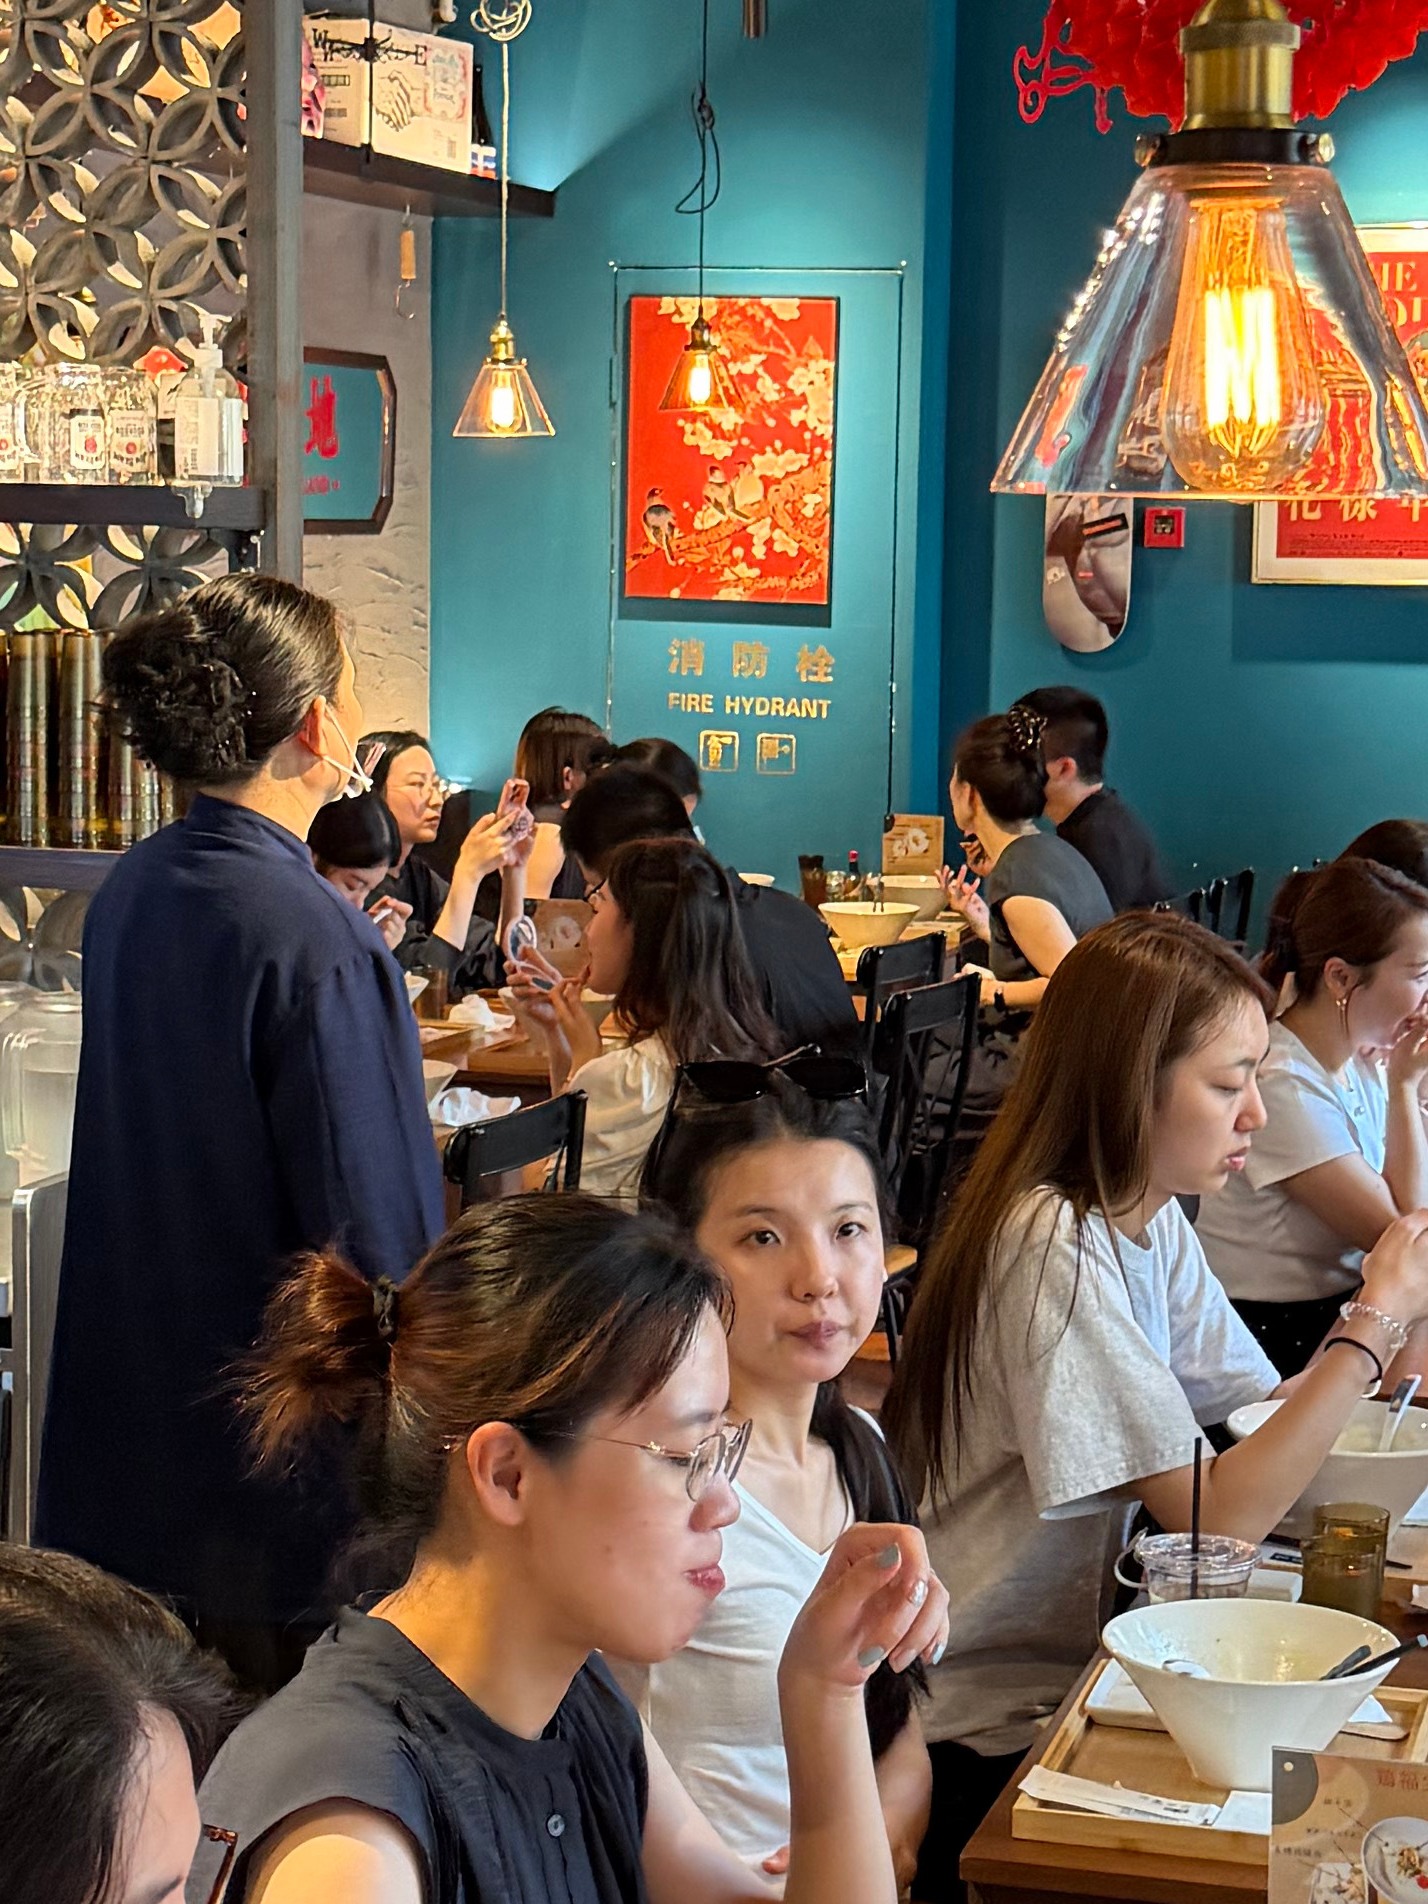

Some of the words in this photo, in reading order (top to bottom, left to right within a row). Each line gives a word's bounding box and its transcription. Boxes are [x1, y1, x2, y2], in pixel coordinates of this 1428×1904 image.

[667, 637, 835, 683] 消防栓
[667, 692, 714, 714] FIRE
[724, 695, 832, 720] HYDRANT
